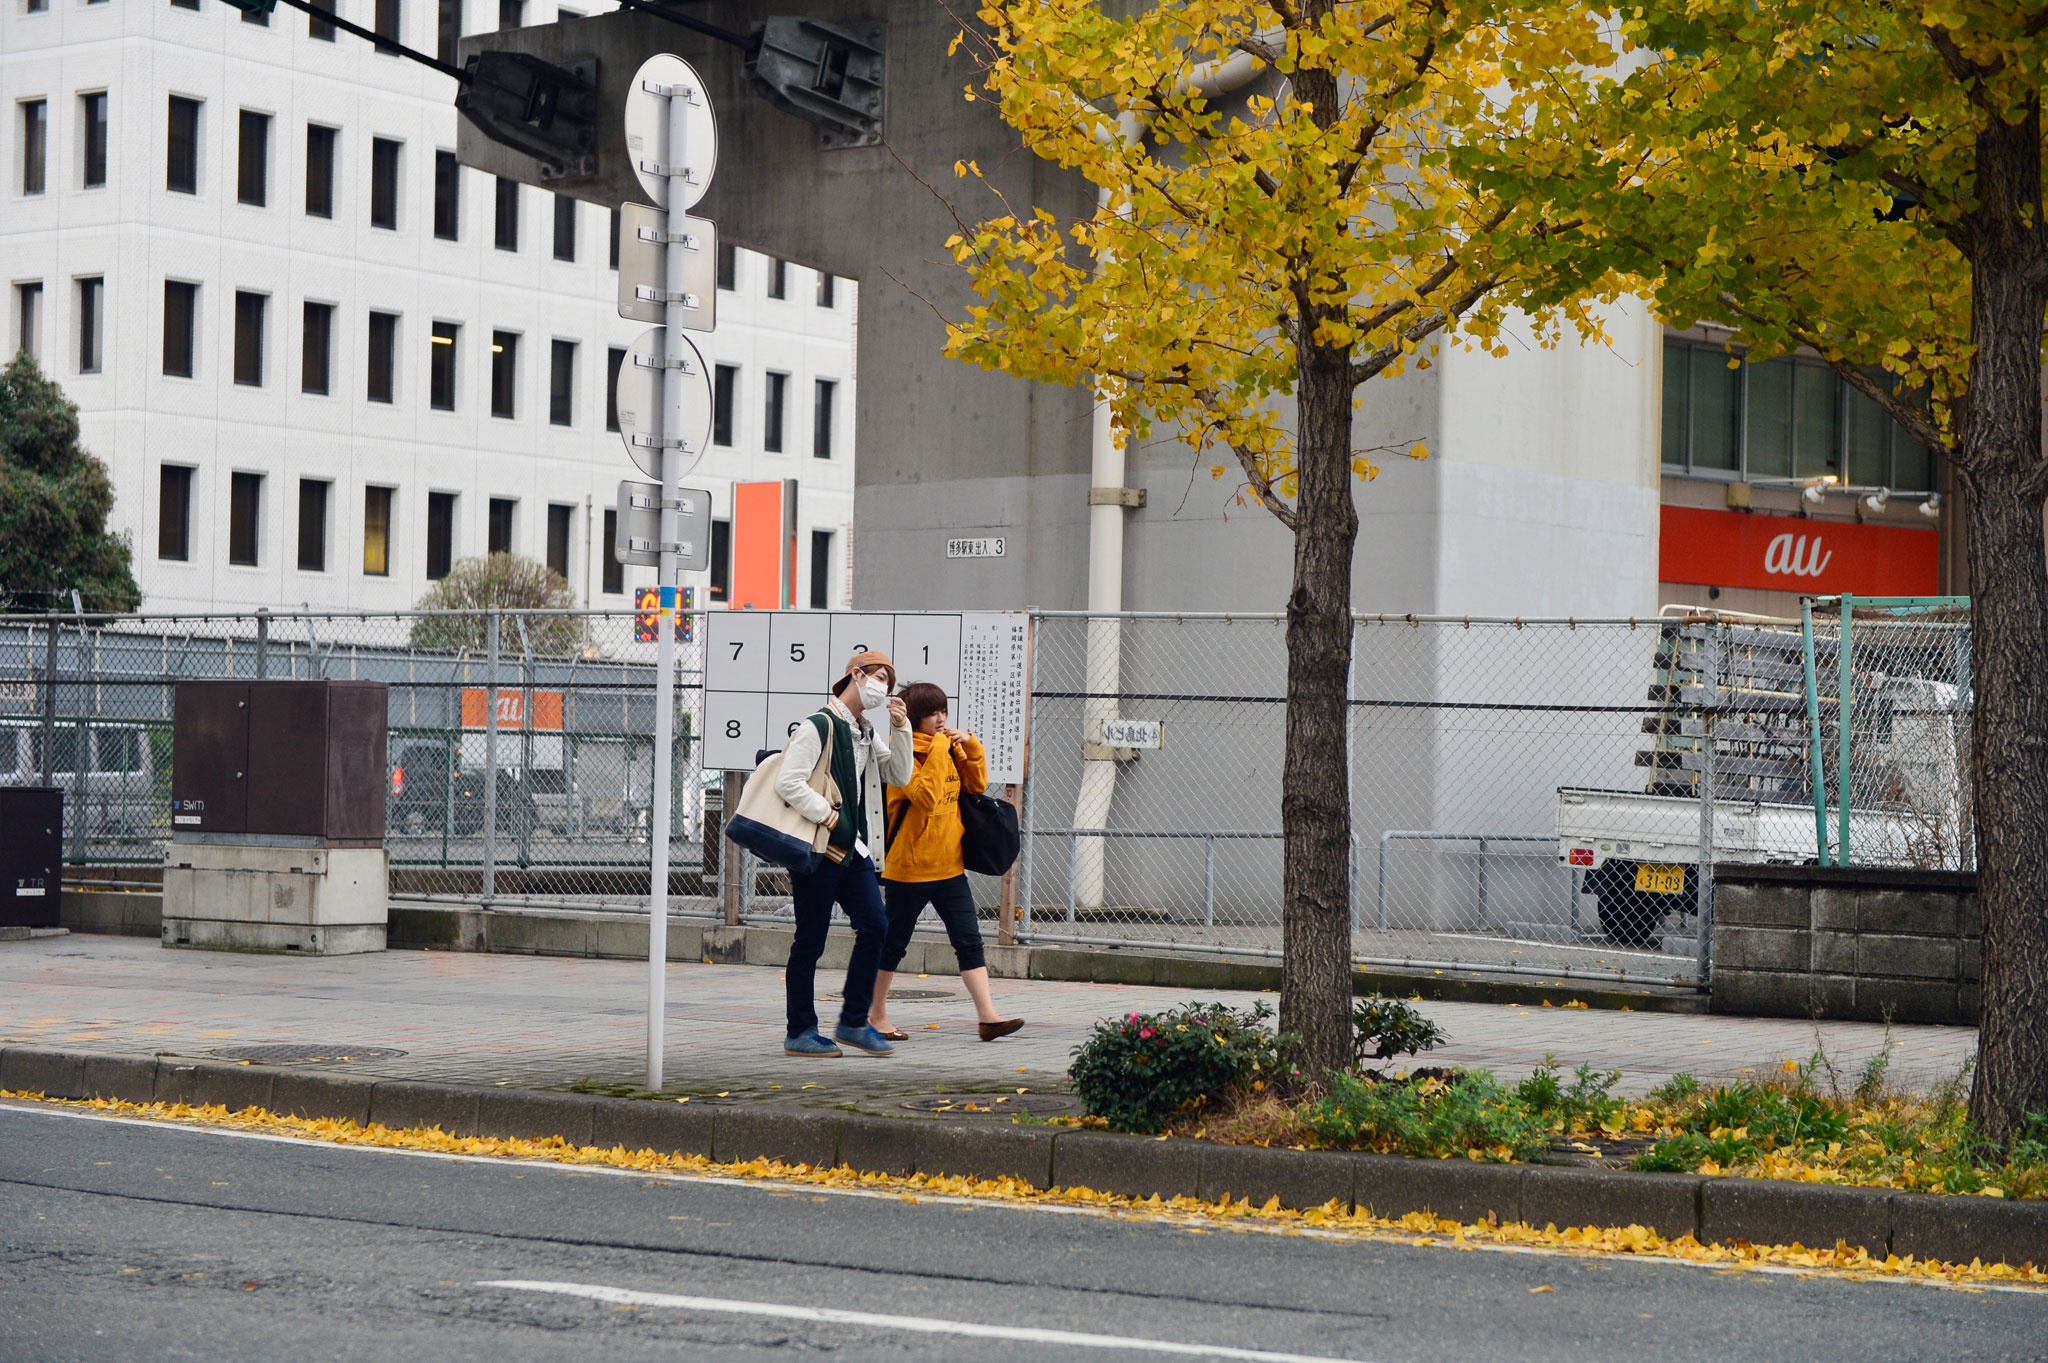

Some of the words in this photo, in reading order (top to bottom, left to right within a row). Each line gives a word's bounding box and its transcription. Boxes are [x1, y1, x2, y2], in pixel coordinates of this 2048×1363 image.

[995, 539, 1003, 554] 3
[1765, 533, 1832, 577] au
[729, 642, 744, 660] 7
[790, 643, 805, 662] 5
[922, 645, 929, 665] 1
[725, 720, 741, 738] 8
[183, 800, 205, 811] SW(T)
